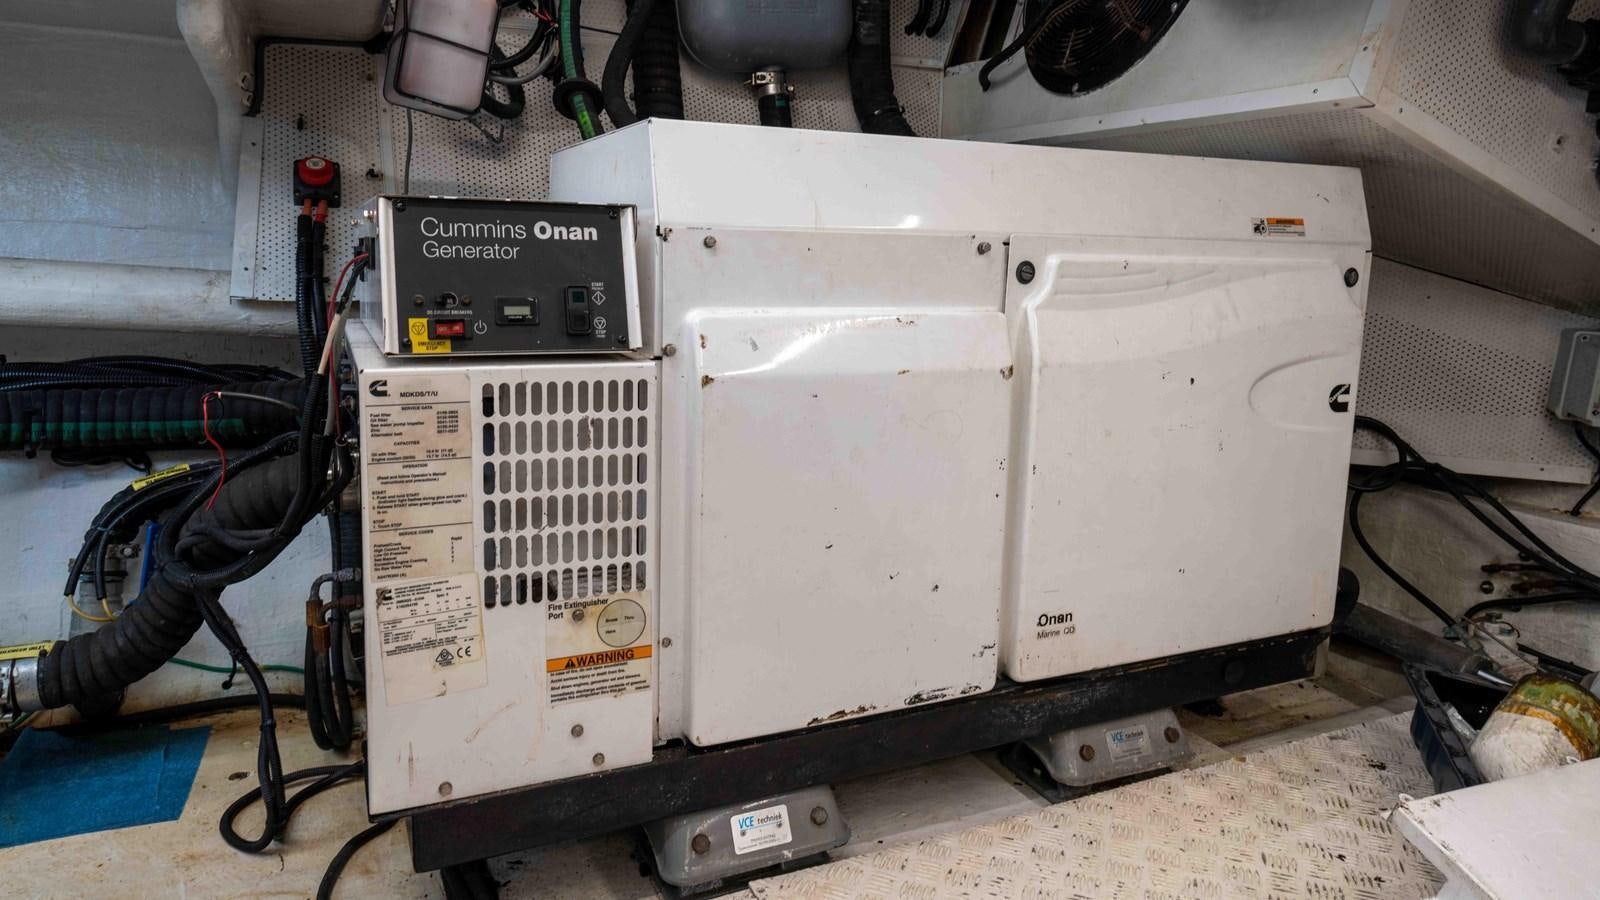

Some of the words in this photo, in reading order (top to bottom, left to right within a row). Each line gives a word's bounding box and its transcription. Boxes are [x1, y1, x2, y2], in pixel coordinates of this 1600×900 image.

[420, 216, 526, 239] Cummins
[534, 220, 598, 241] Onan
[422, 240, 520, 259] Generator
[564, 598, 608, 610] Extinguisher
[548, 612, 563, 620] Port
[1038, 612, 1072, 626] Onan
[1037, 630, 1060, 640] Marine
[576, 649, 634, 667] WARNING
[738, 816, 754, 829] VCE
[758, 812, 782, 824] techniek
